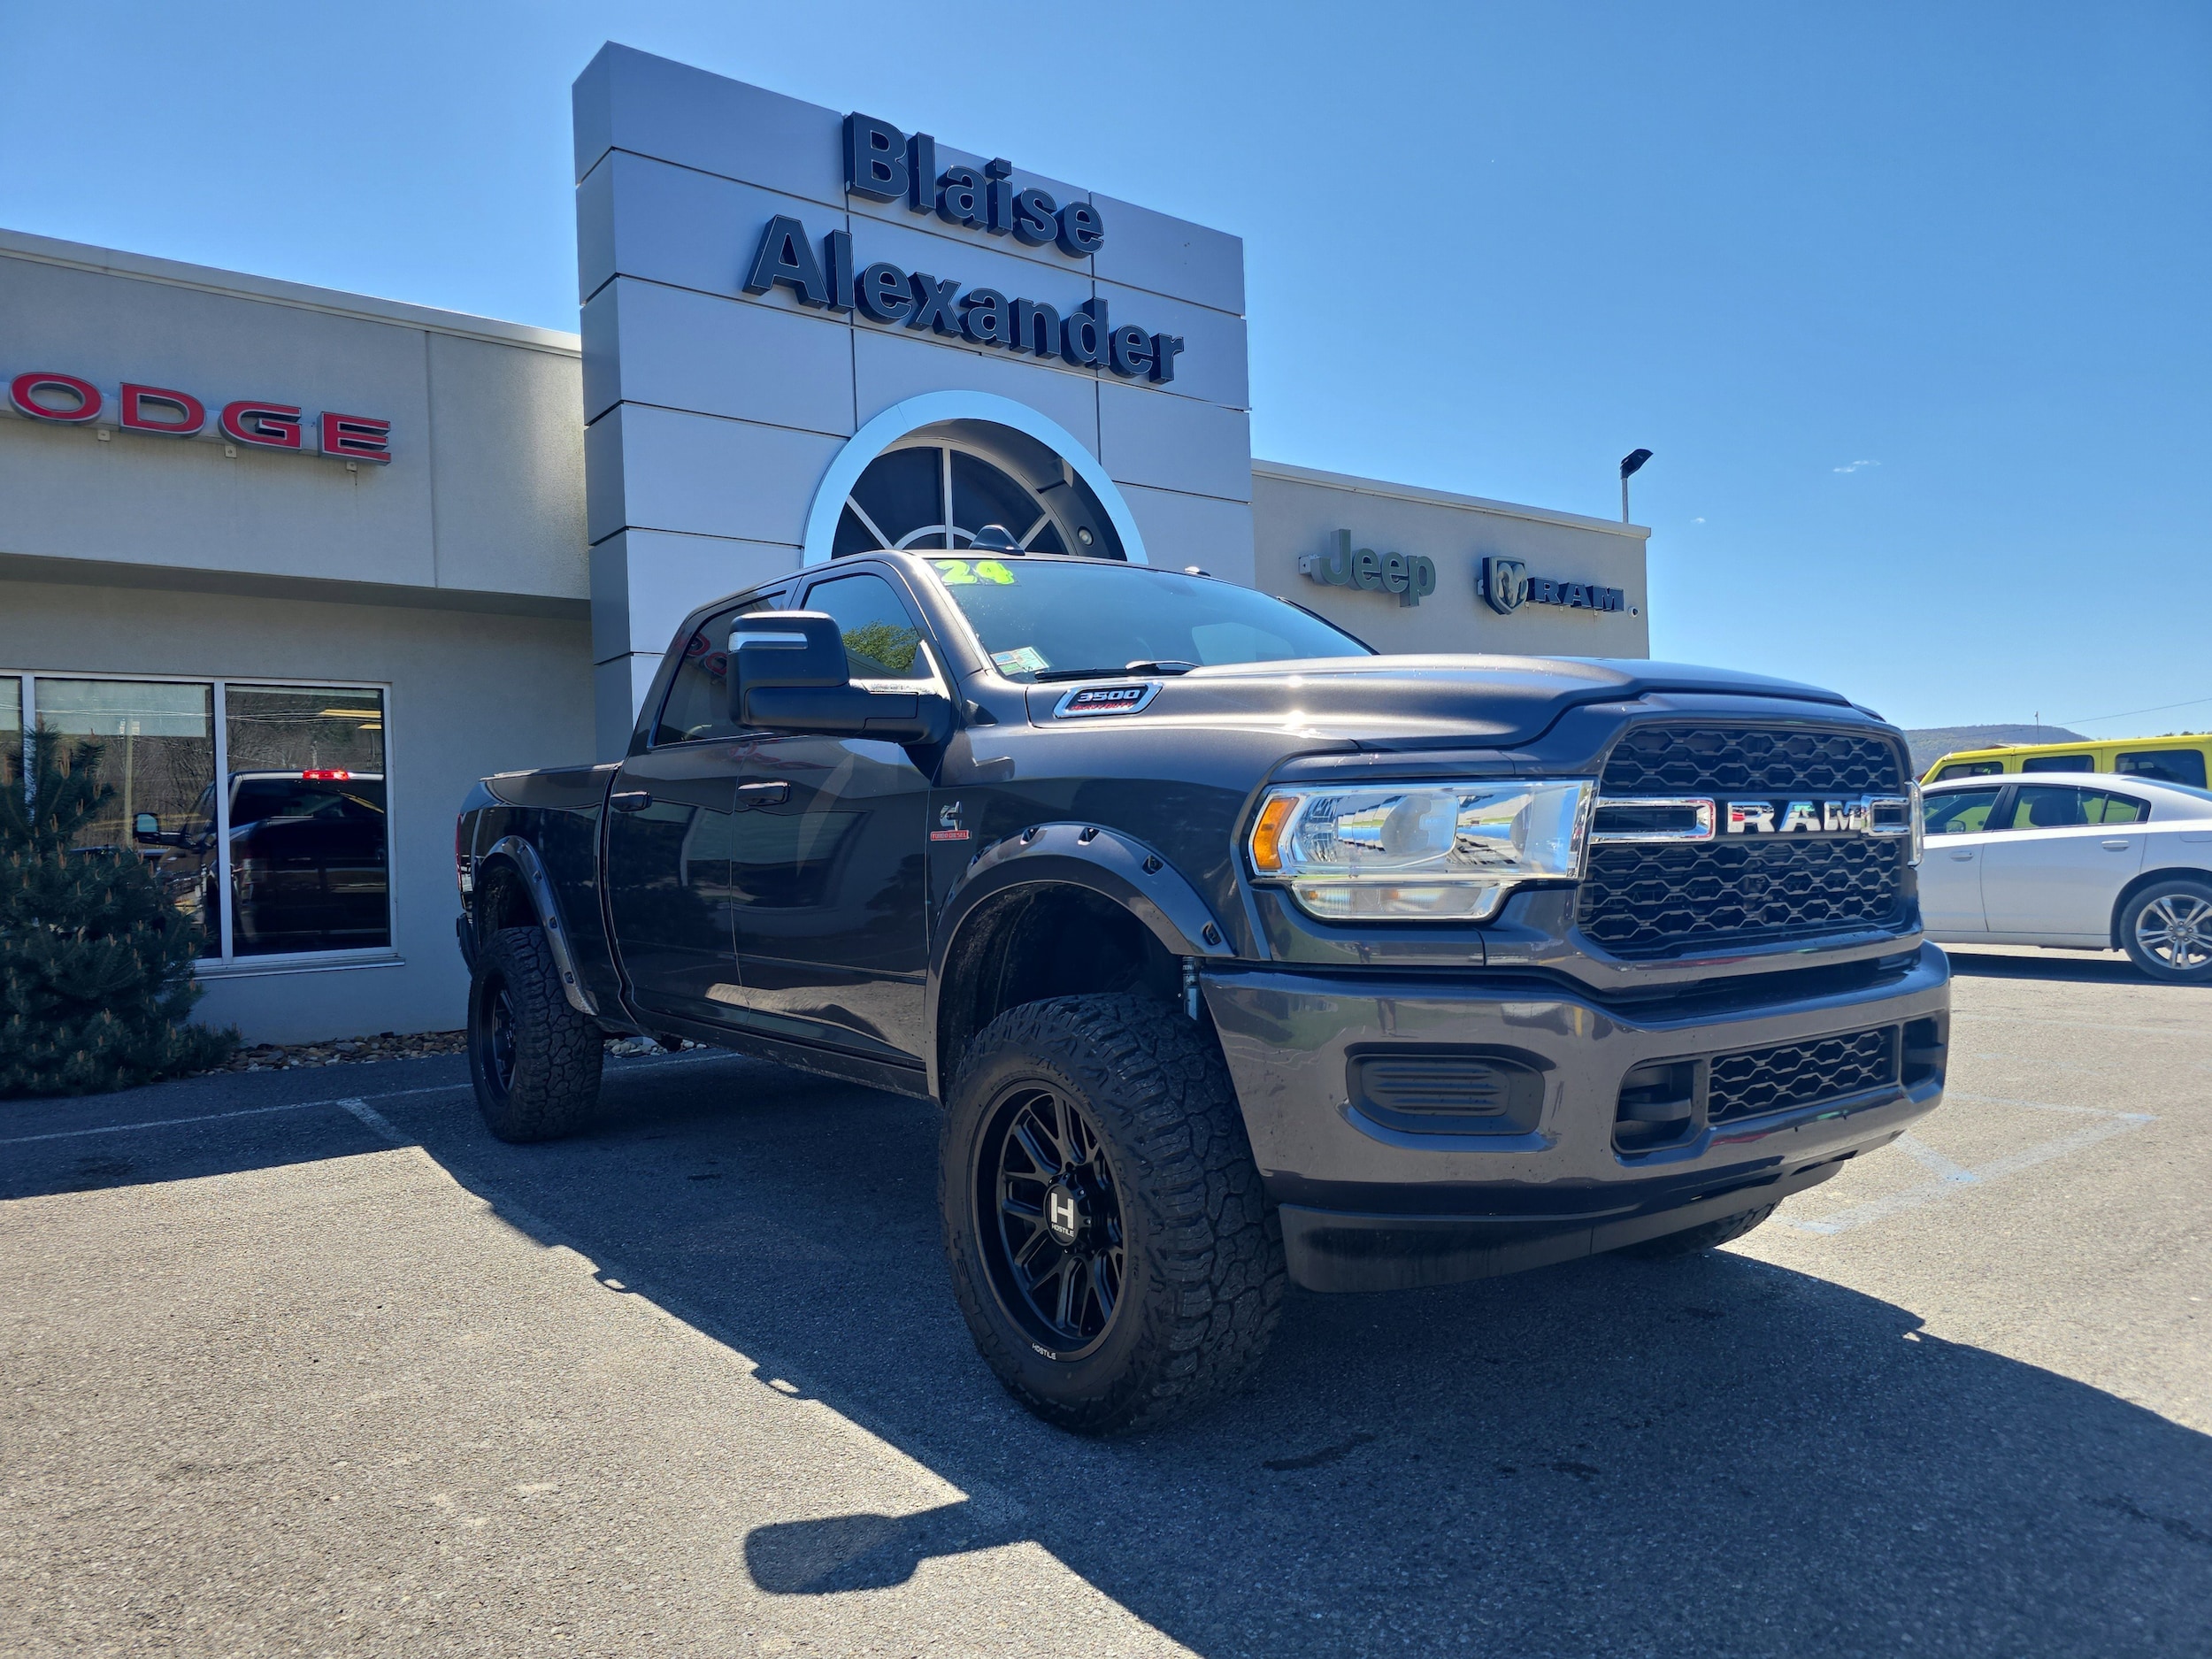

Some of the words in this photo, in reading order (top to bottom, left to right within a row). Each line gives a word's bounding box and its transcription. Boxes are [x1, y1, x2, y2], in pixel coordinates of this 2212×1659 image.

[843, 111, 1104, 258] Blaise
[742, 214, 1184, 384] Alexander
[1310, 528, 1436, 608] Jeep
[1527, 577, 1624, 612] RAM
[1077, 689, 1141, 703] 3500
[1727, 801, 1862, 833] RAM
[1050, 1192, 1074, 1230] H
[1051, 1223, 1075, 1238] HOSTILE
[1032, 1342, 1056, 1360] HOSTILE
